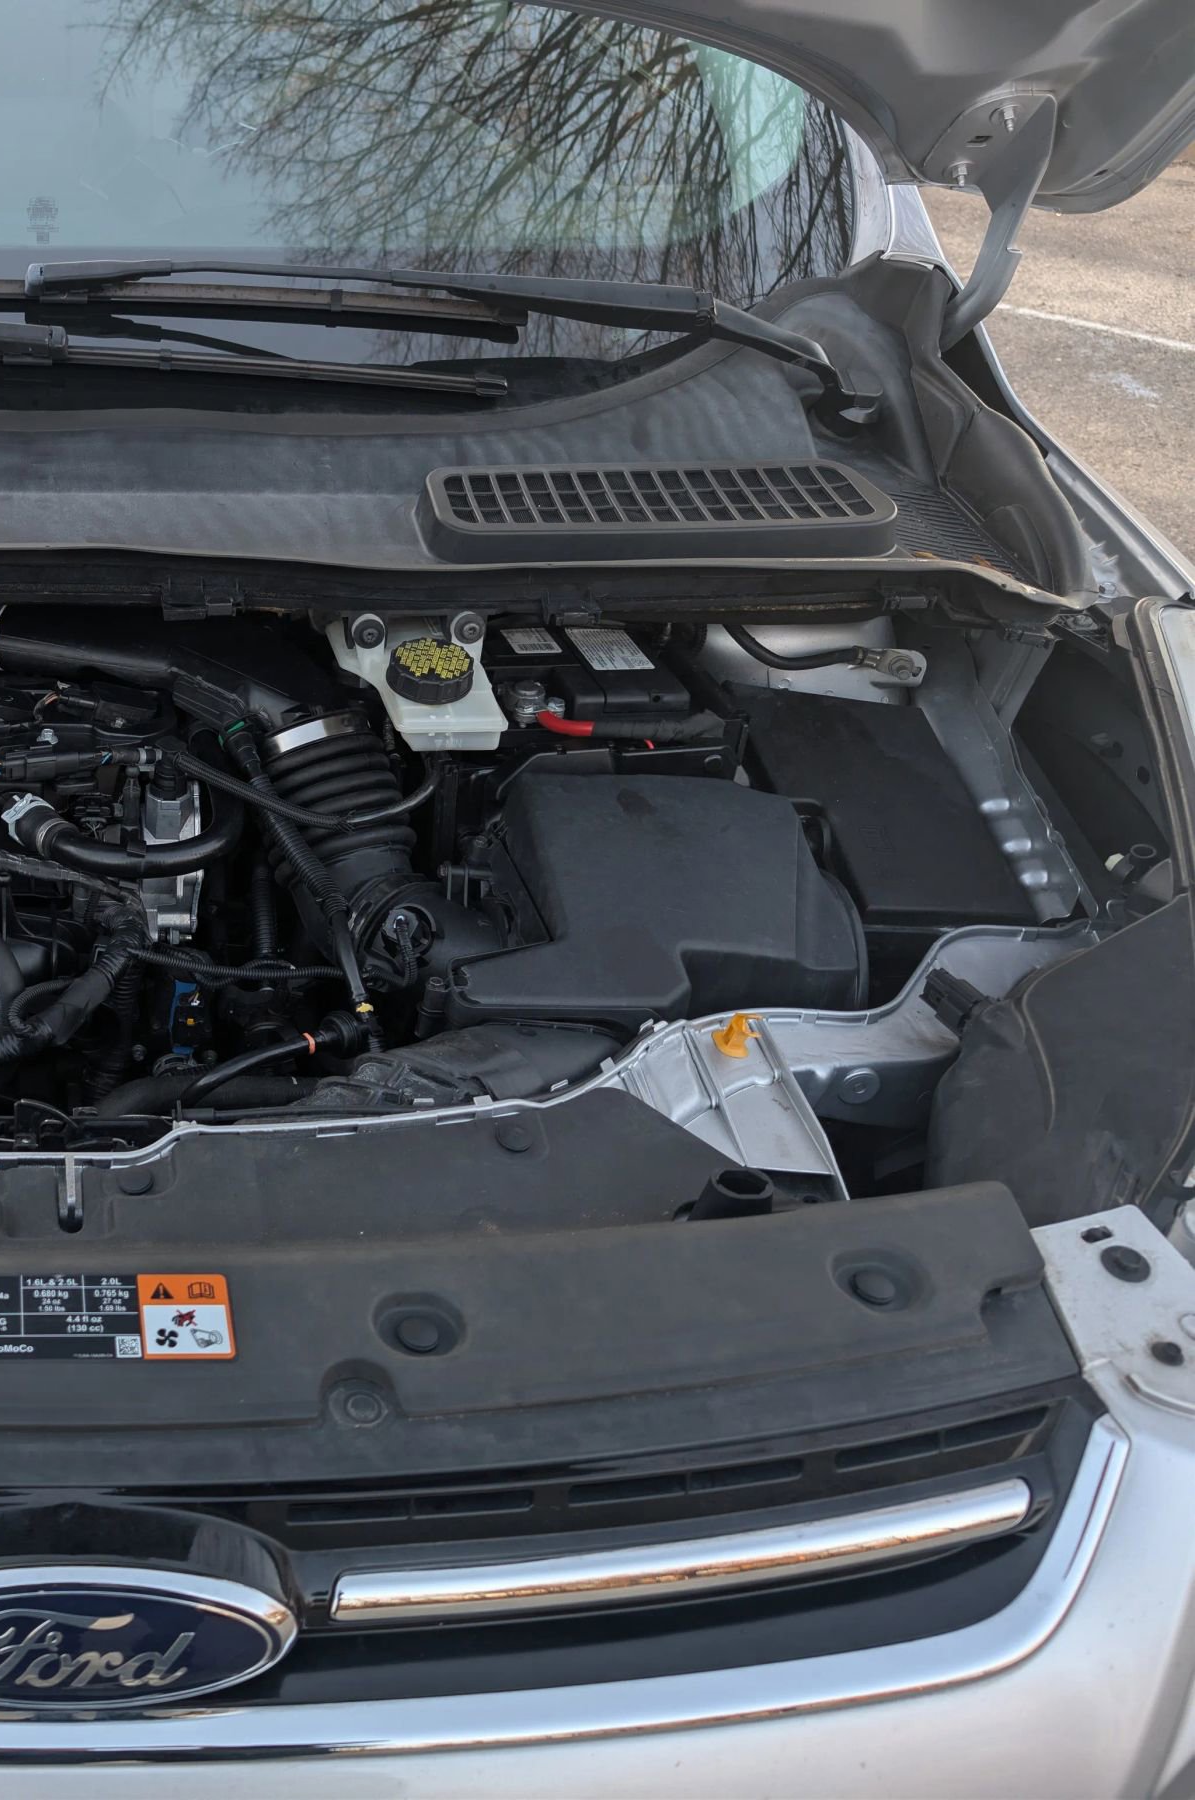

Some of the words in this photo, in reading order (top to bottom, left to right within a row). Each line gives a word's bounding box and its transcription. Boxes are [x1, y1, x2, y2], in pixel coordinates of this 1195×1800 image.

[26, 1278, 44, 1286] 1.6L
[48, 1278, 55, 1286] &
[57, 1278, 78, 1286] 2.5L
[101, 1277, 122, 1285] 2.0L
[33, 1289, 56, 1298] 0.680
[58, 1289, 69, 1299] kg
[94, 1289, 117, 1297] 0.765
[118, 1289, 129, 1299] kg
[66, 1315, 81, 1323] 4.4
[82, 1315, 89, 1323] fl
[67, 1324, 87, 1333] (130
[89, 1324, 104, 1333] cc)
